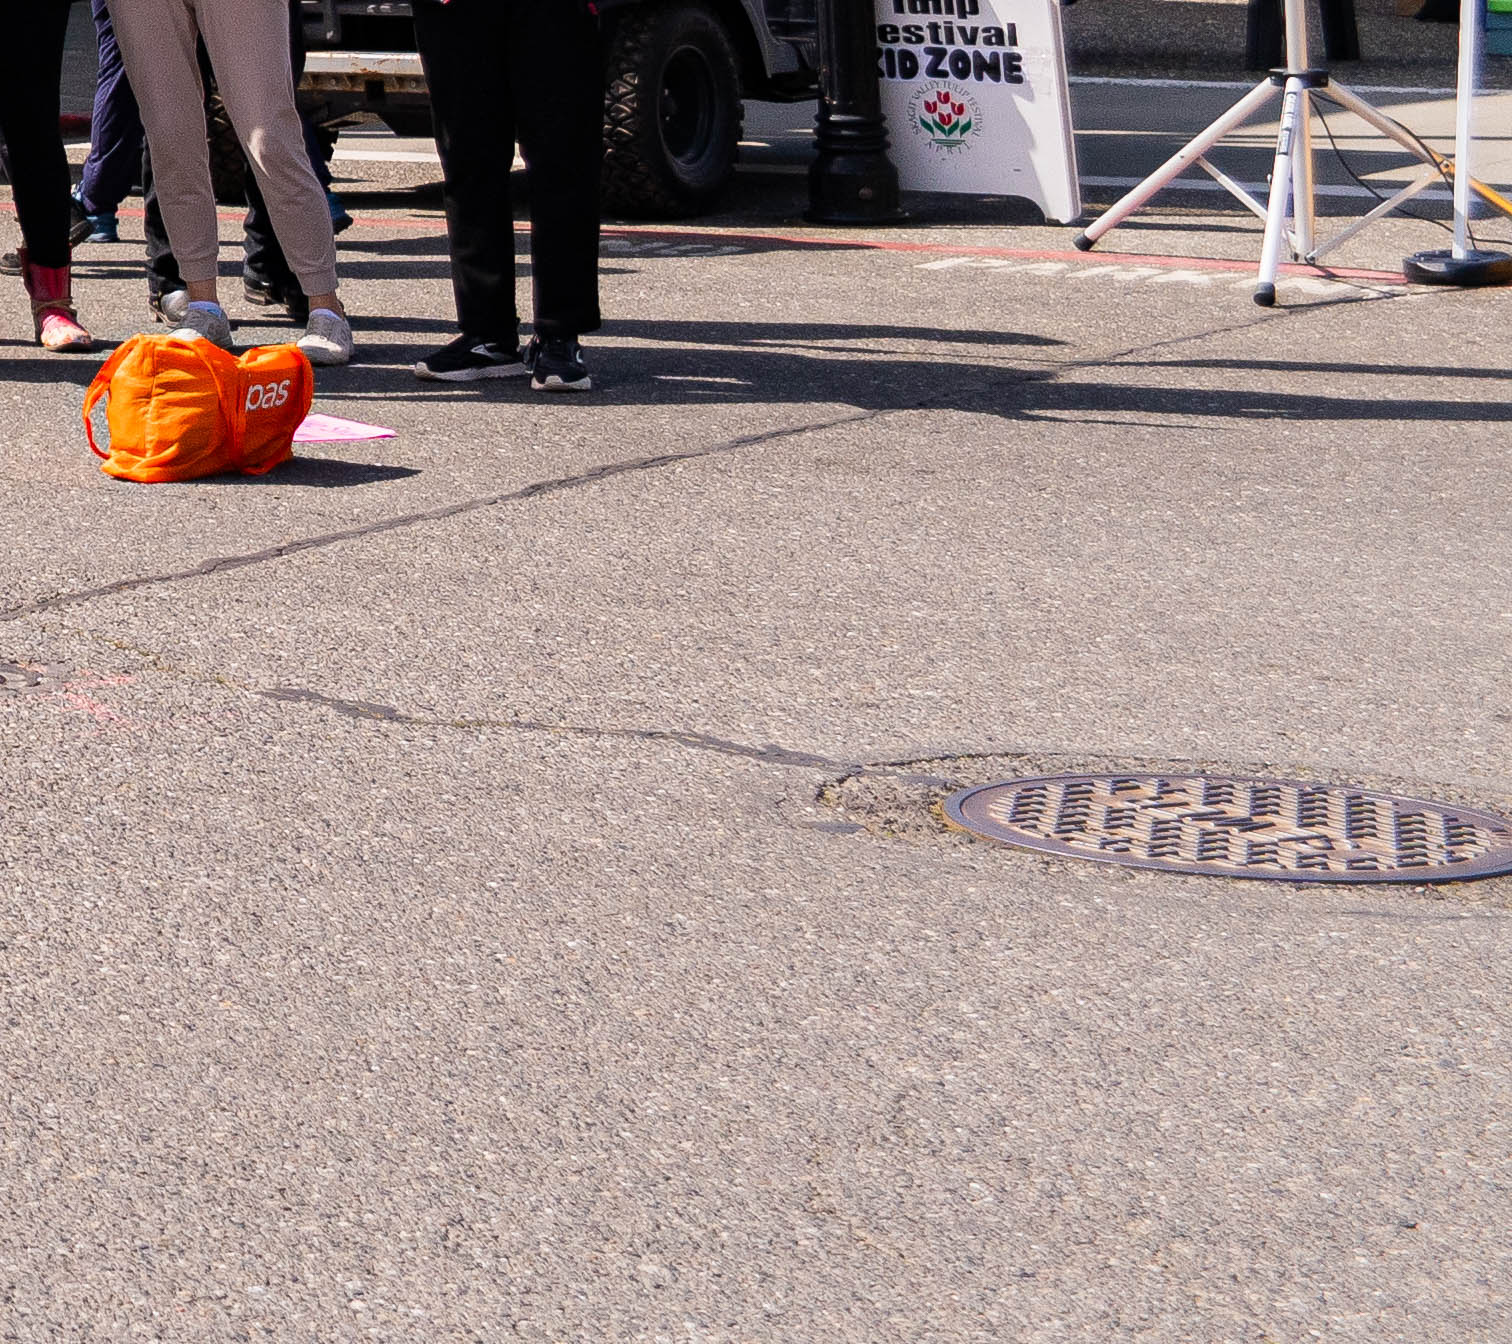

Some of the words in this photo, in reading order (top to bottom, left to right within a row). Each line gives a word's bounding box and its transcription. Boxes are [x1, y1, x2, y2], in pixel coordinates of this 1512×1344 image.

[877, 21, 1018, 46] estival
[924, 47, 1024, 84] ZONE
[924, 141, 972, 154] APRIL
